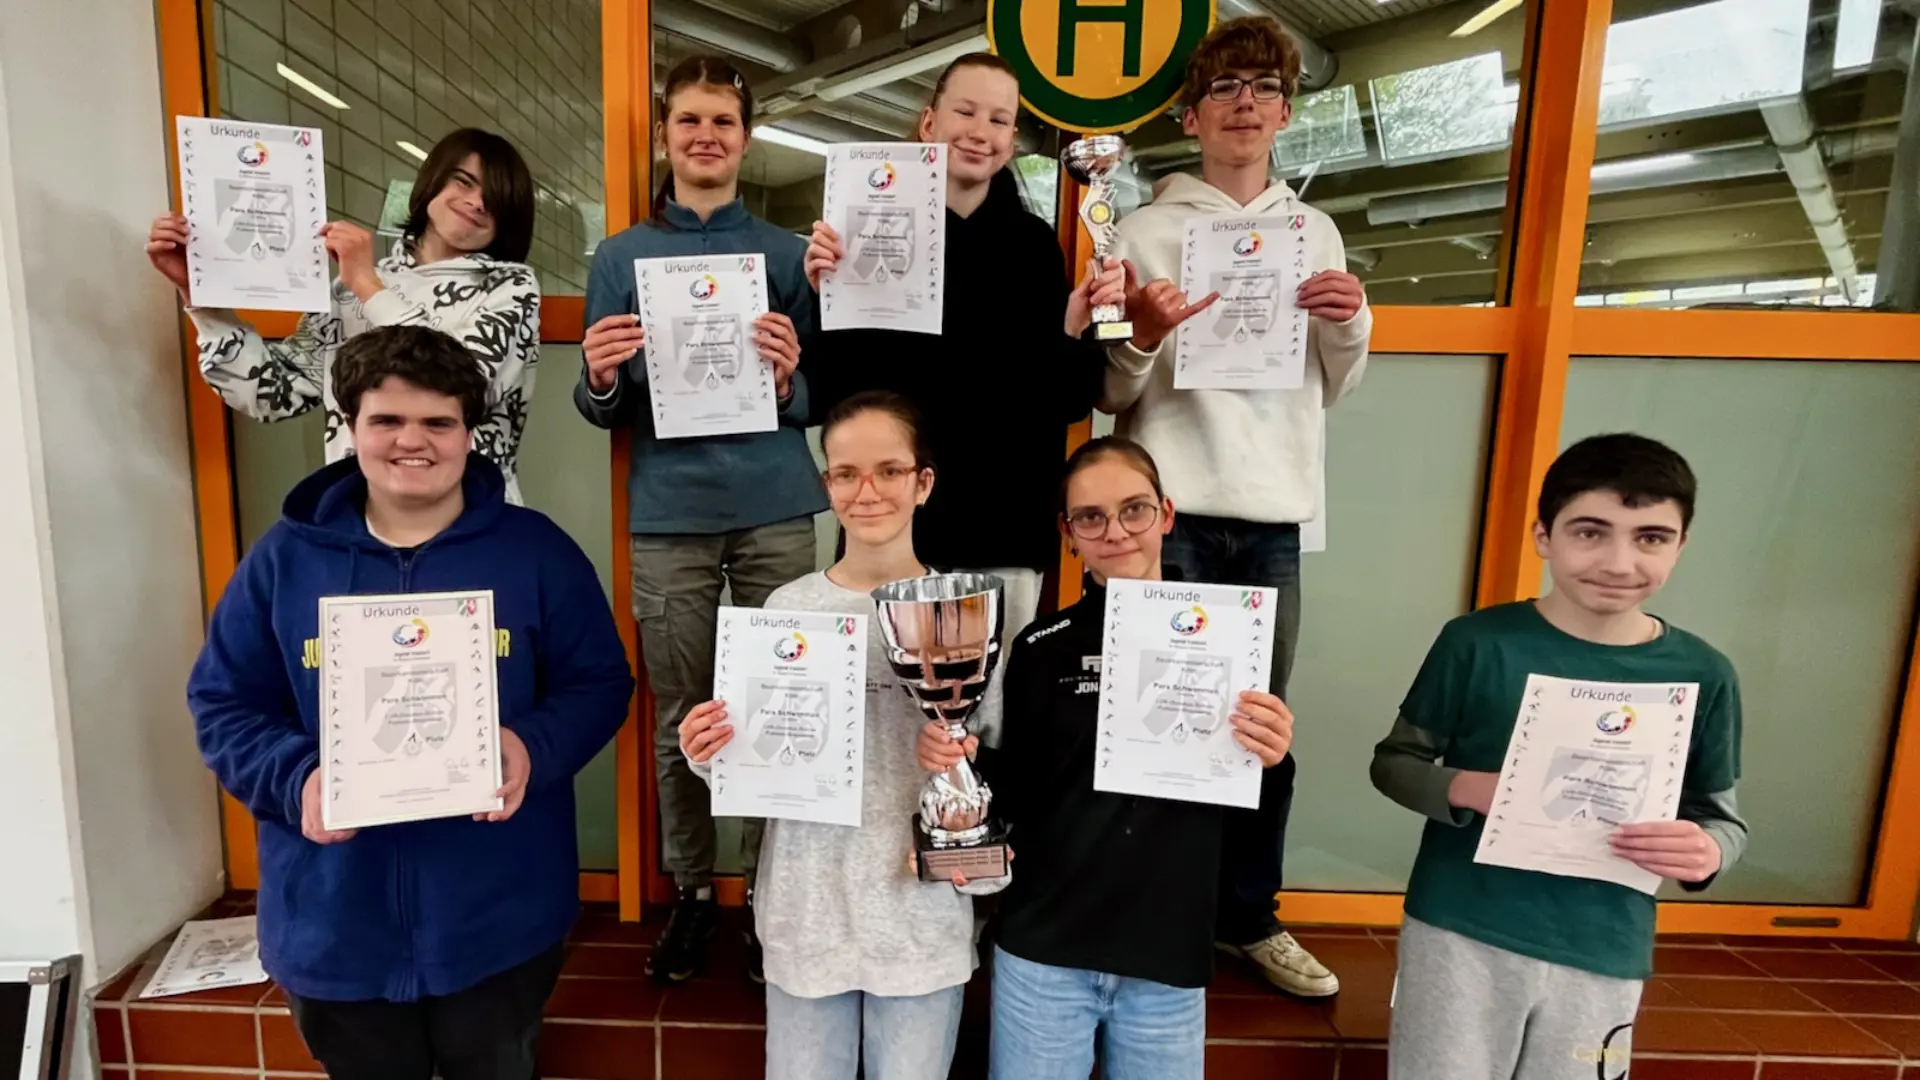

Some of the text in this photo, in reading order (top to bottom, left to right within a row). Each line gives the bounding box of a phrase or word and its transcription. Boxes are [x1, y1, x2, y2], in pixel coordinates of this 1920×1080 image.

[1056, 0, 1144, 77] H
[210, 124, 260, 139] Urkunde
[850, 149, 891, 160] Urkunde
[1212, 221, 1257, 233] Urkunde
[665, 262, 711, 274] Urkunde
[1144, 587, 1201, 602] Urkunde
[362, 605, 420, 619] Urkunde
[750, 615, 801, 629] Urkunde
[1570, 687, 1632, 702] Urkunde
